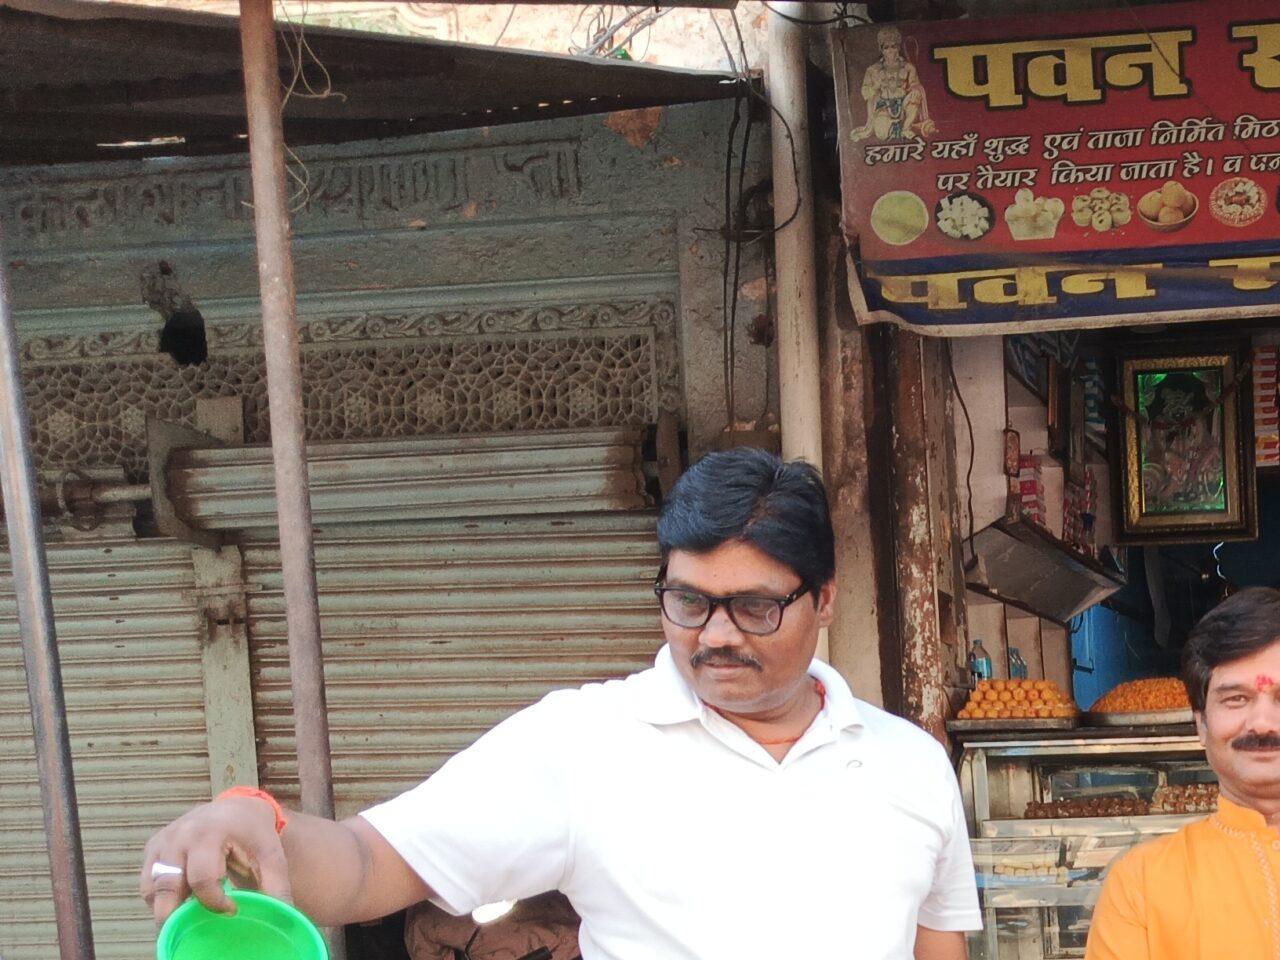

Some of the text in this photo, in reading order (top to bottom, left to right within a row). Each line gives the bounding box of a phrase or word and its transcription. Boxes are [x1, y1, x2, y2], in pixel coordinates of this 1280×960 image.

[934, 30, 1194, 107] पवन
[865, 137, 926, 165] हमारे
[931, 132, 978, 159] यहाँ
[983, 136, 1031, 162] शुद्ध
[1042, 127, 1084, 159] एवं
[1087, 128, 1145, 149] ताजा
[1151, 117, 1226, 145] निर्मित
[937, 173, 970, 191] पर
[976, 165, 1038, 189] तैयार
[1051, 160, 1114, 185] किया
[1120, 159, 1177, 180] जाता
[1223, 156, 1243, 173] व
[881, 263, 1163, 310] पवन
